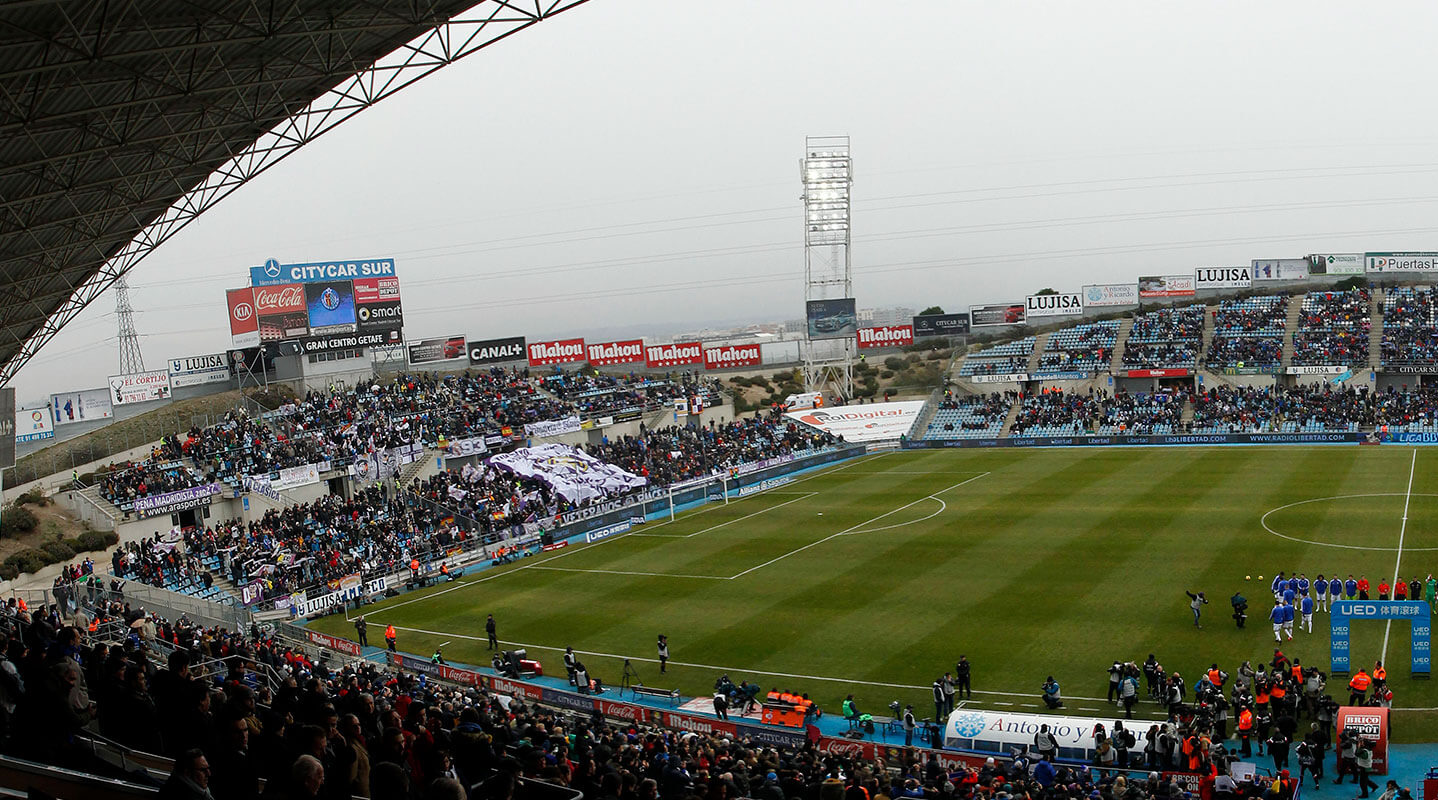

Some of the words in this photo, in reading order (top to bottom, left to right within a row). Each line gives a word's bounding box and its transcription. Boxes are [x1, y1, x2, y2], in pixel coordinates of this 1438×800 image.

[291, 263, 358, 280] CITYCAR
[361, 261, 392, 275] SUR
[1388, 258, 1430, 269] Puertas
[1197, 269, 1250, 281] LUJISA
[257, 287, 303, 309] Coca-Cola
[1028, 296, 1081, 309] LUJISA
[236, 306, 250, 318] KIA
[371, 305, 401, 318] smart
[306, 340, 328, 350] GRAN
[329, 337, 357, 348] CENTRO
[358, 335, 383, 345] GETAFE
[859, 328, 912, 342] Mahou
[471, 344, 523, 360] CANAL+
[530, 343, 583, 359] Mahou
[589, 344, 642, 361] Mahou
[648, 345, 700, 362] Mahou
[705, 346, 759, 363] Mahou
[186, 356, 224, 370] LUJISA
[125, 378, 134, 386] EL
[136, 375, 167, 385] CORTIJO
[460, 438, 487, 453] 93
[1250, 434, 1345, 442] WWW.RADIOLIBERTAD.COM
[146, 497, 211, 516] www.arasport.es
[155, 491, 194, 507] MADRIDISTA
[306, 592, 342, 614] LUJISA
[343, 577, 386, 602] IMECO
[1341, 605, 1377, 615] UED
[494, 677, 525, 696] Mahou
[607, 703, 635, 720] Coca-Cola
[669, 714, 712, 733] Mahou
[1346, 716, 1379, 724] BRICO
[759, 732, 789, 744] CITYCAR
[1073, 726, 1088, 743] y
